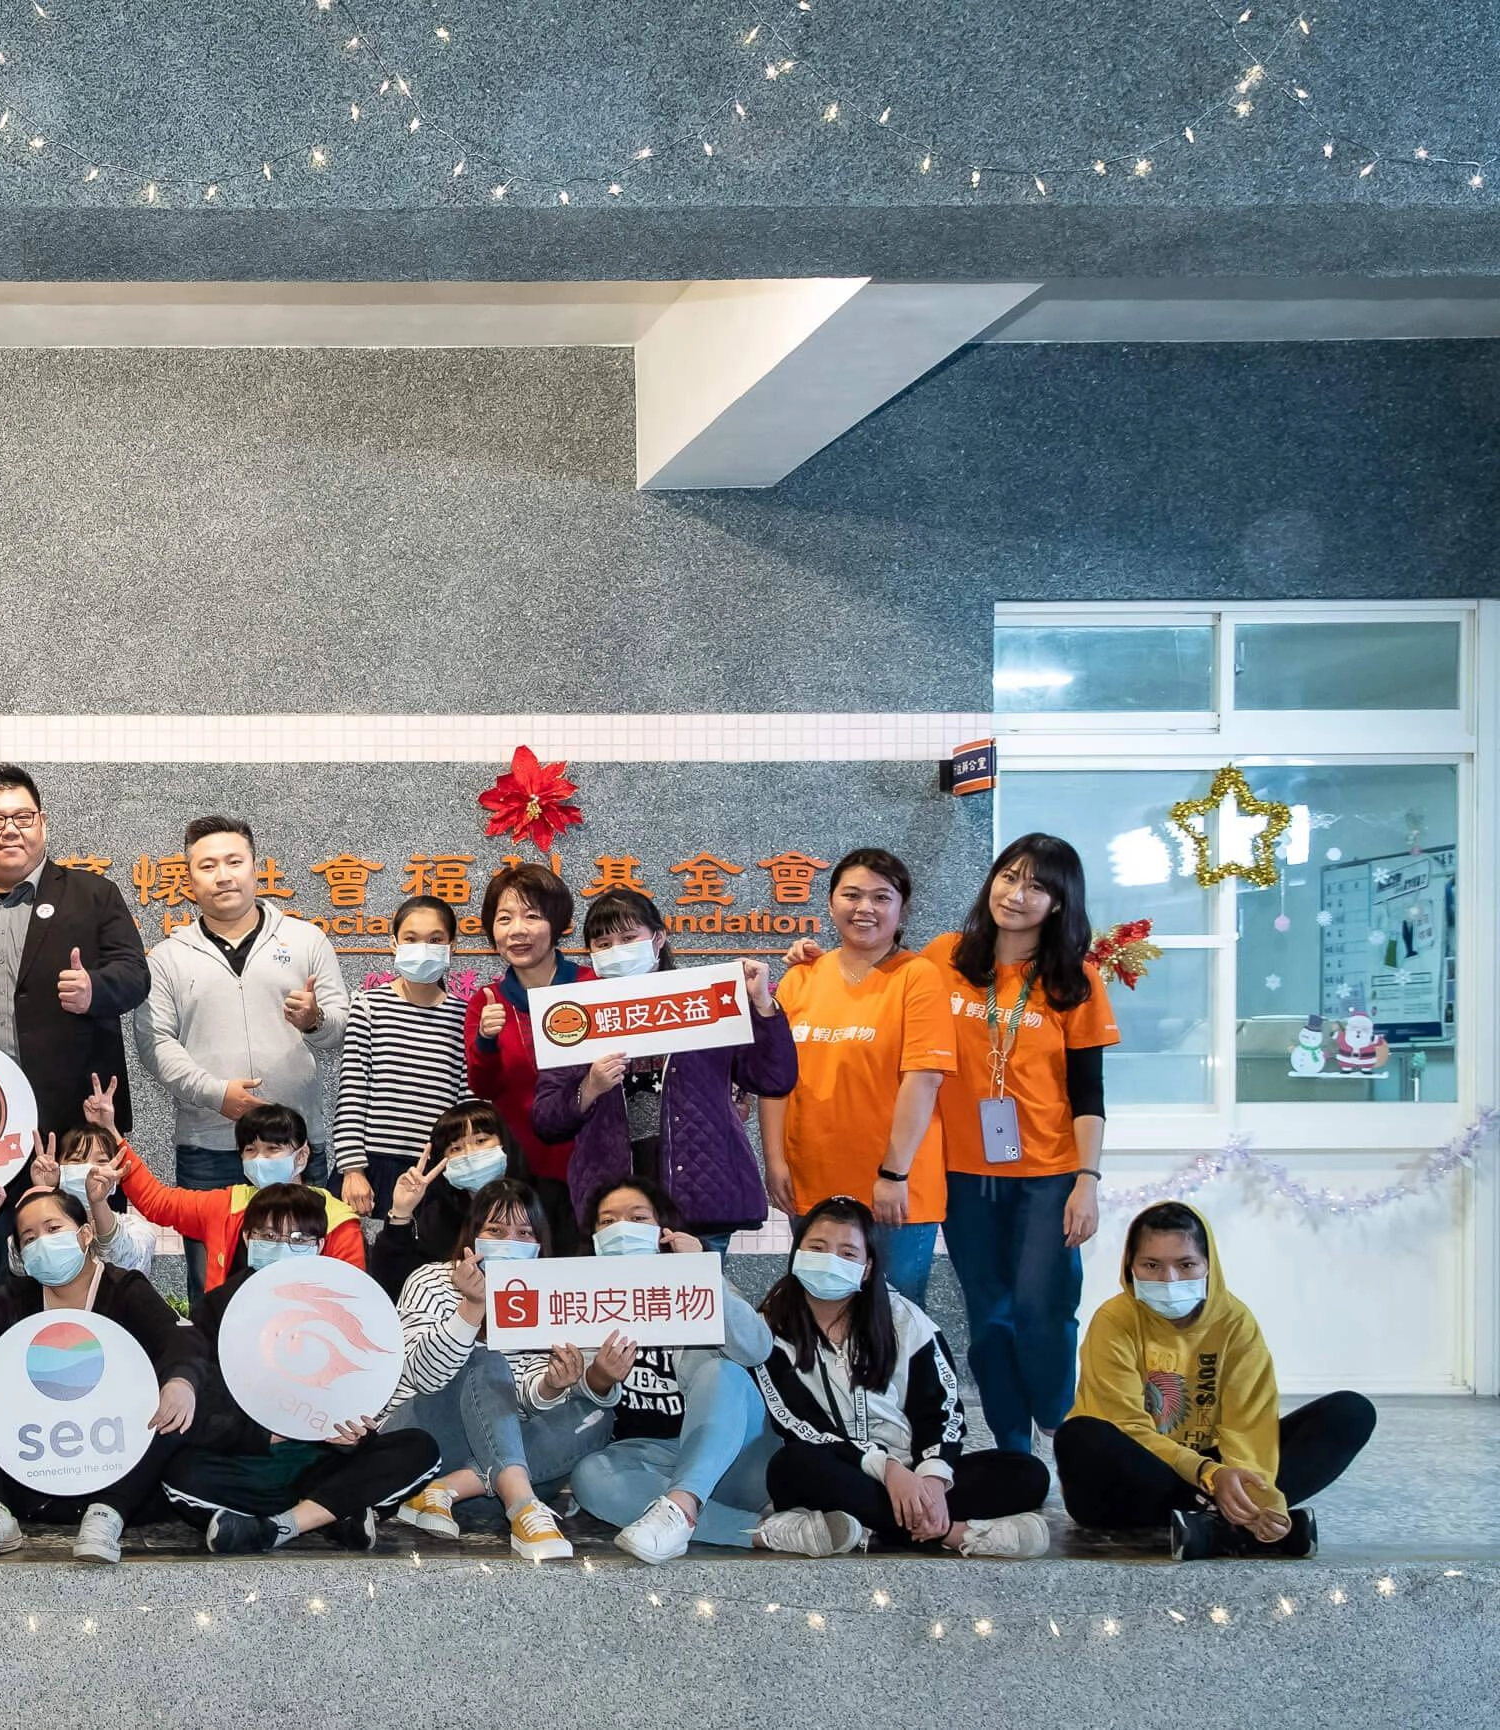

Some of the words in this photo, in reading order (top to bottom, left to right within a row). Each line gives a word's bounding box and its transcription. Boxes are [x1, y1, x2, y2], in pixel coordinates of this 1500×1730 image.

[594, 996, 711, 1034] 蝦皮公益
[507, 1295, 527, 1322] S
[549, 1285, 715, 1325] 蝦皮購物
[1195, 1353, 1218, 1407] BOYS
[18, 1415, 126, 1462] sea
[26, 1464, 82, 1478] connecting
[85, 1463, 100, 1473] the
[102, 1463, 123, 1472] dots
